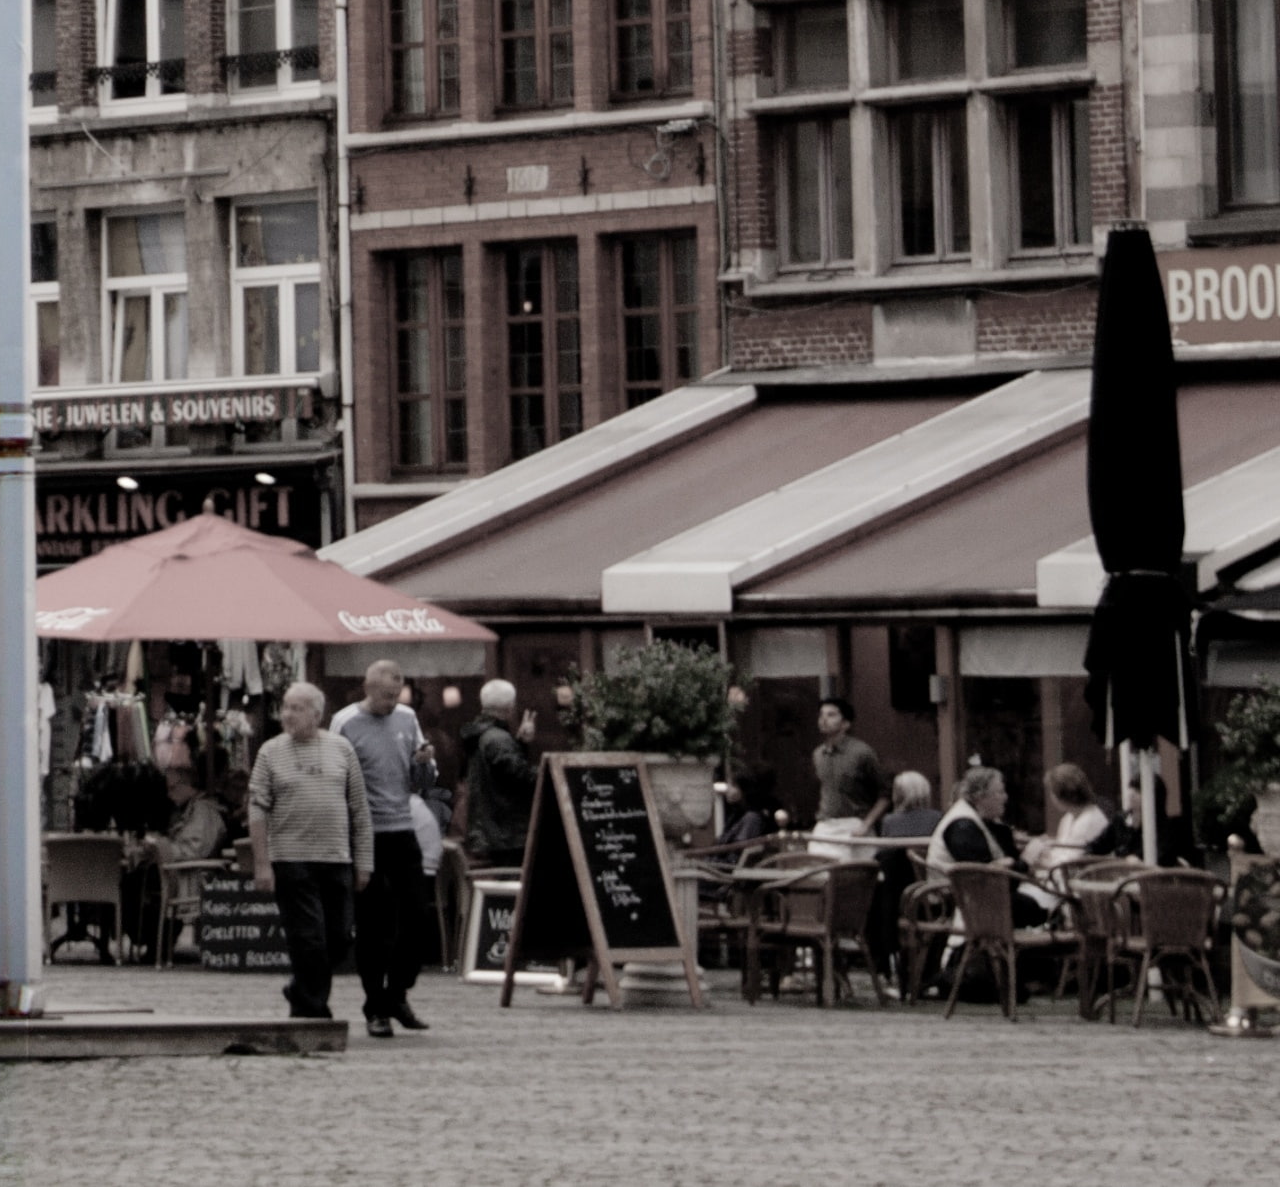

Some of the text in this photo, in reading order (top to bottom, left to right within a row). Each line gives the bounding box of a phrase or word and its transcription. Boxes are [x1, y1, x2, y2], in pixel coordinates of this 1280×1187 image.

[65, 400, 144, 427] JUWELEN
[150, 399, 165, 423] &
[172, 394, 276, 423] SOUVENIRS
